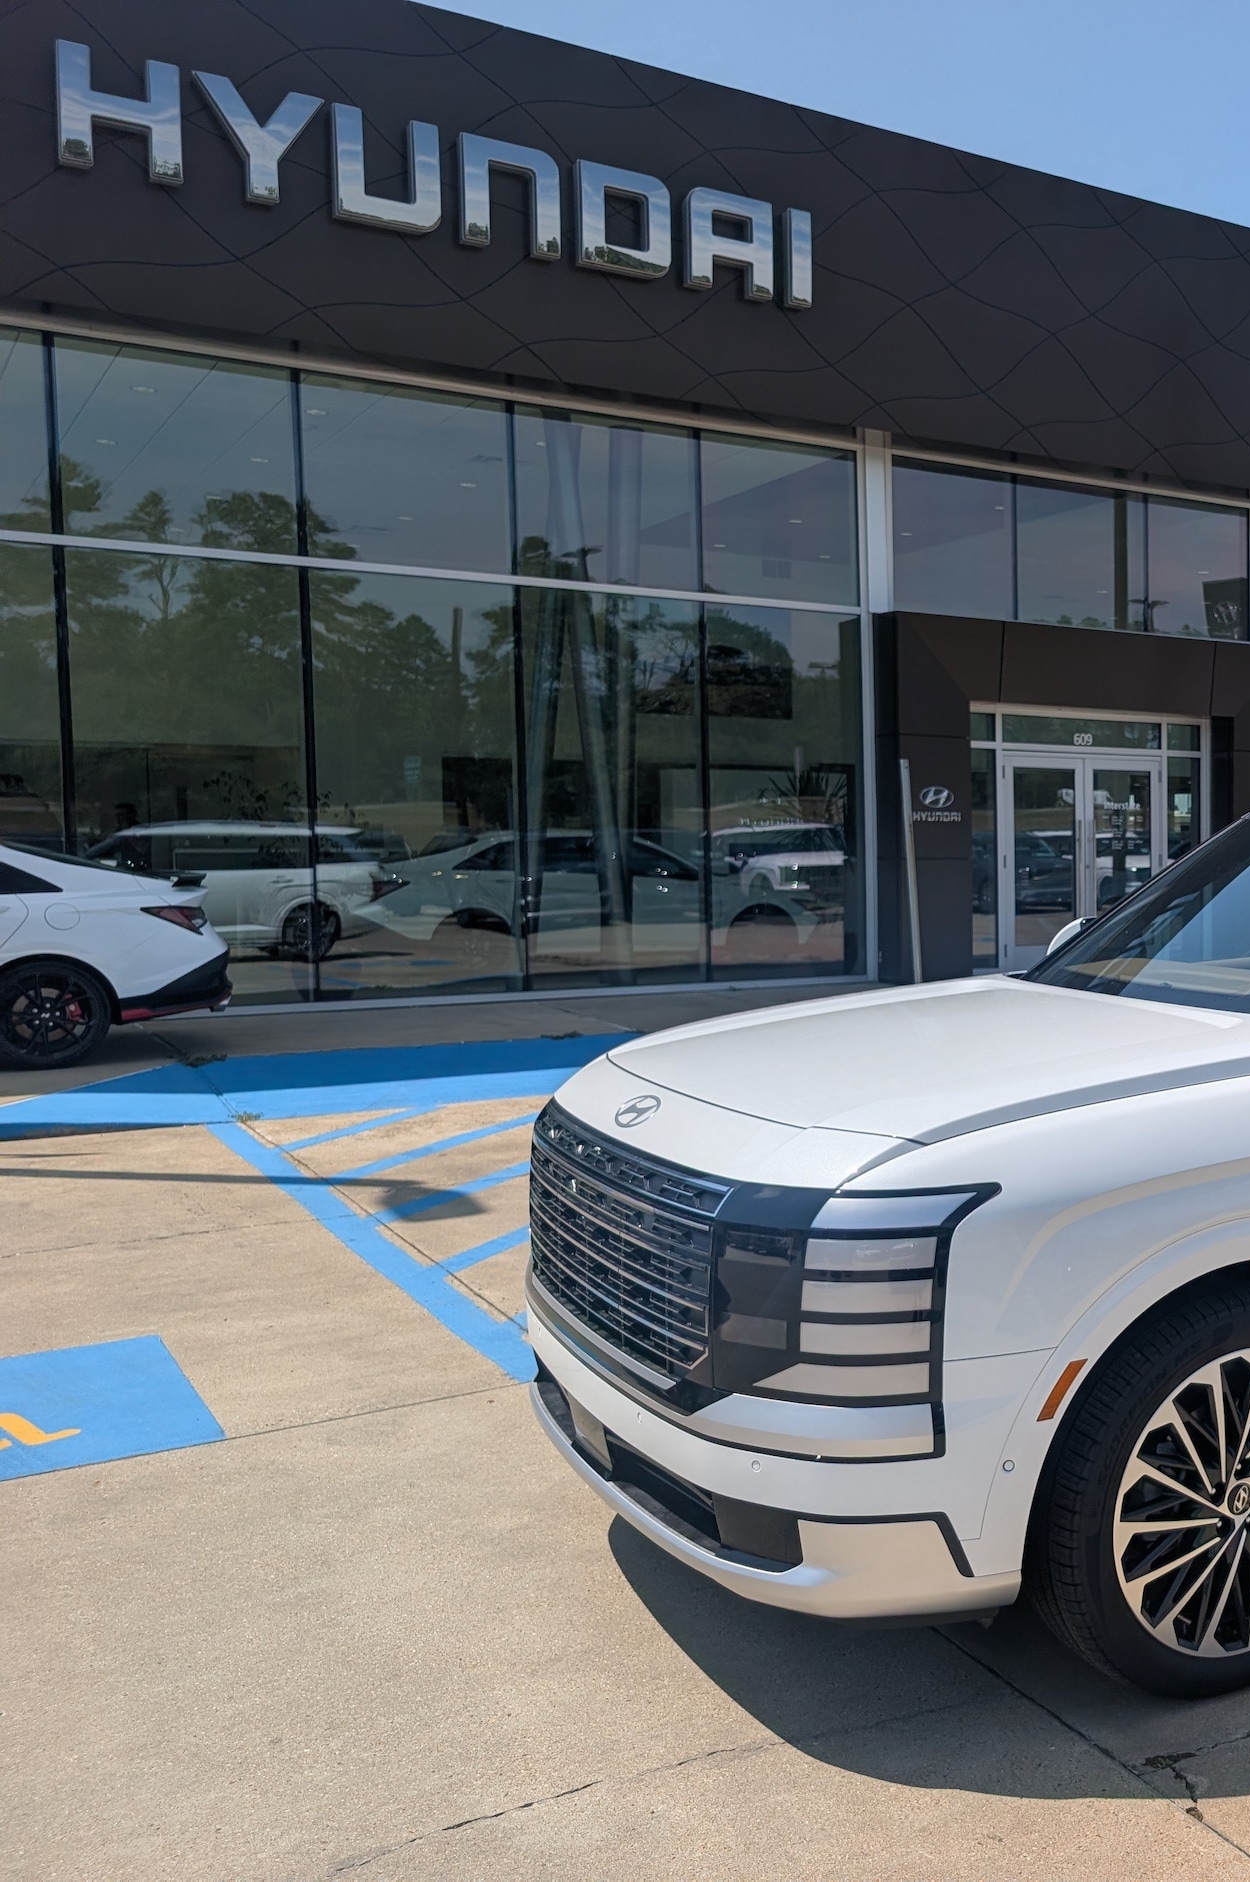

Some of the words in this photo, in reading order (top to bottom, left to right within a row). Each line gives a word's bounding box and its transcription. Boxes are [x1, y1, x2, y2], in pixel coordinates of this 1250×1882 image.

[55, 38, 813, 309] HYUNDAI
[1073, 732, 1093, 746] 609
[912, 811, 962, 822] HYUNDAI
